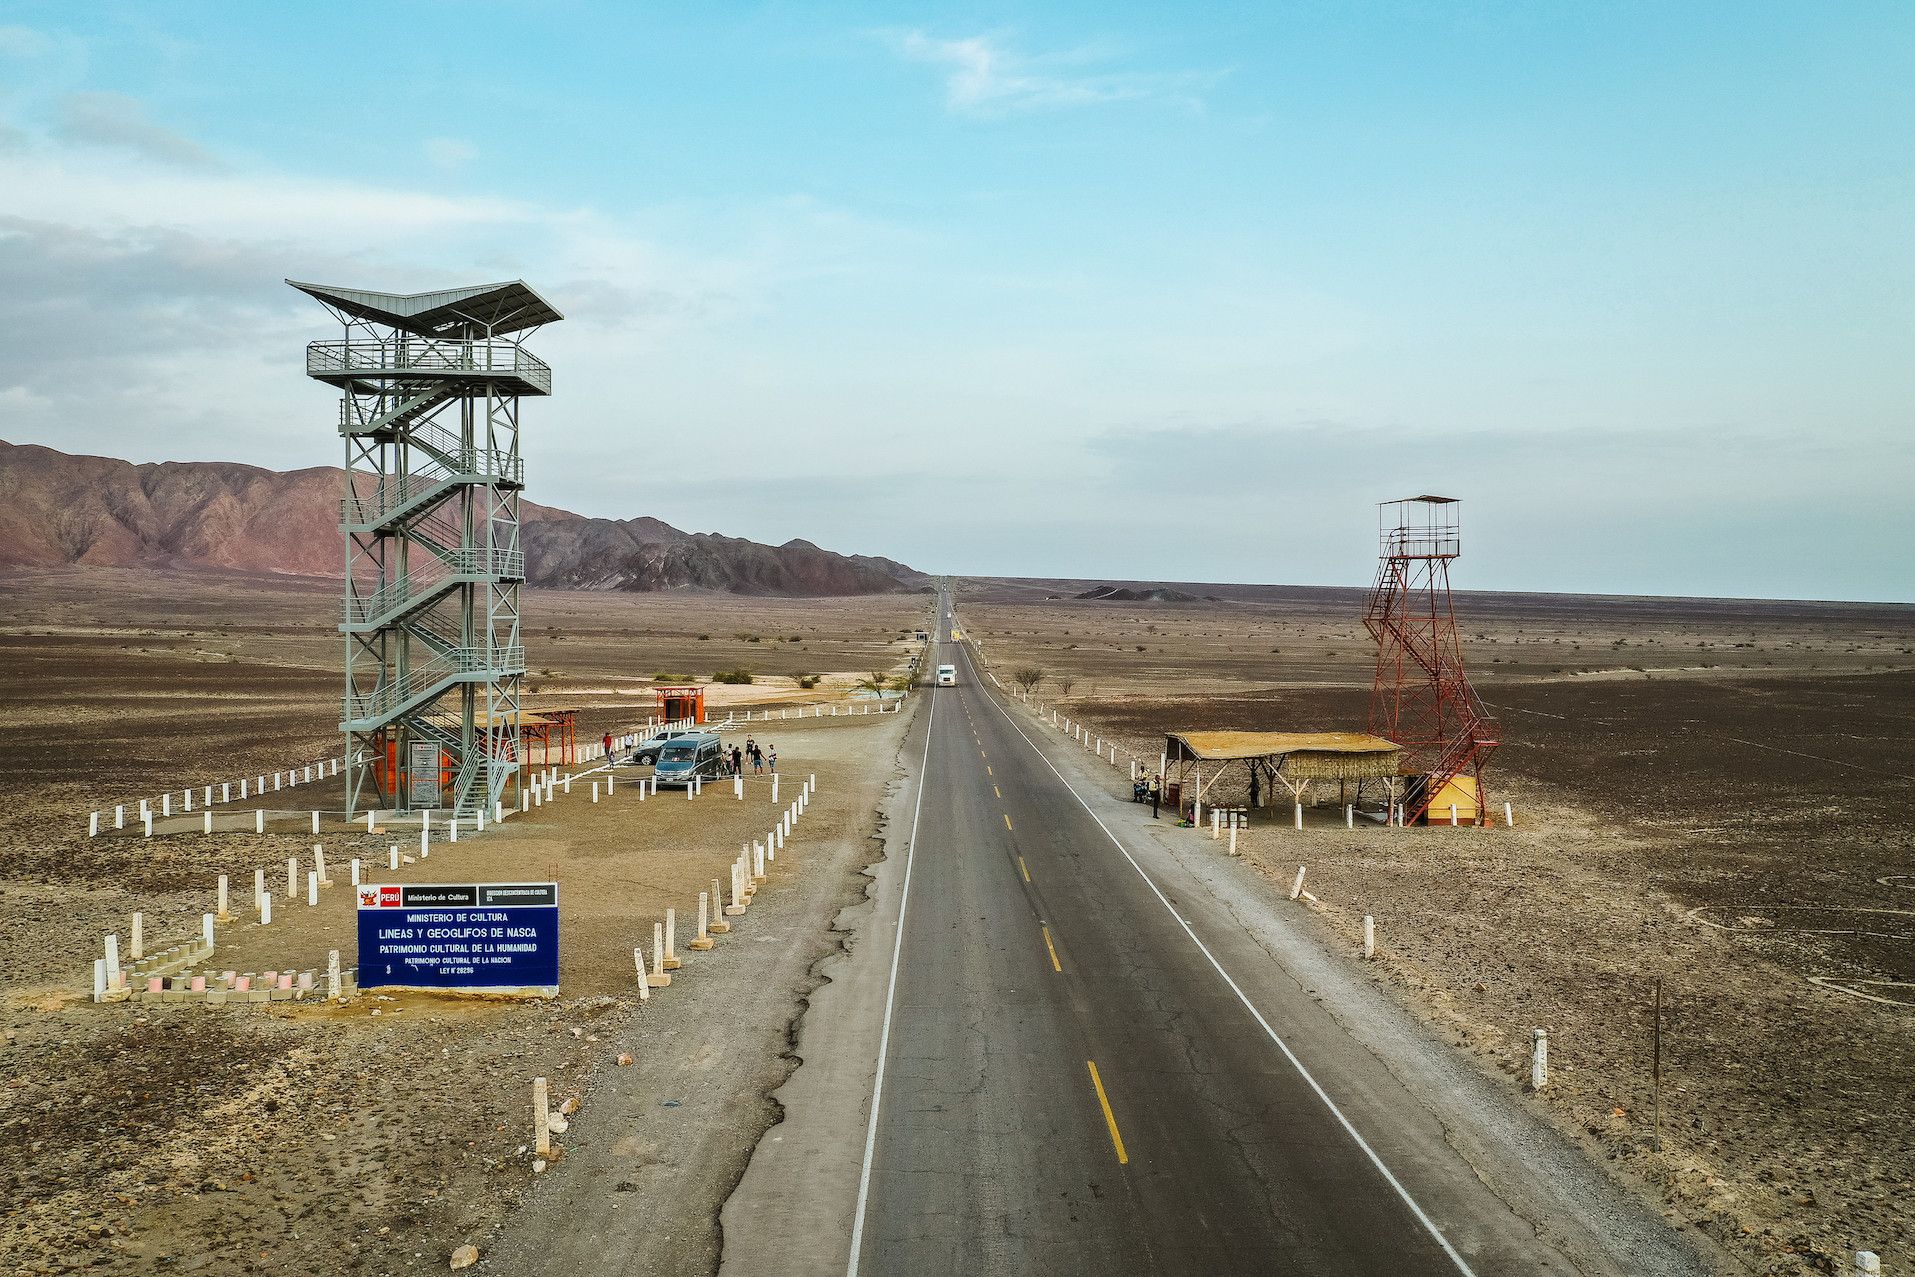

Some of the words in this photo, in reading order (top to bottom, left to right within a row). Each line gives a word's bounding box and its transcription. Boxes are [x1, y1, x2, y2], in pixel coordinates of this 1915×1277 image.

[381, 892, 399, 902] PERÚ
[407, 914, 453, 922] MINISTERIO
[457, 913, 467, 922] DE
[470, 913, 508, 922] CULTURA
[379, 929, 413, 939] LINEAS
[416, 929, 423, 938] Y
[427, 928, 487, 938] GEOGLIFOS
[491, 928, 504, 938] DE
[507, 928, 536, 938] NASCA
[380, 945, 427, 954] PATRIMONIO
[430, 945, 469, 953] CULTURAL
[472, 944, 482, 952] DE
[485, 944, 494, 952] LA
[497, 944, 537, 952] HUMANIDAD
